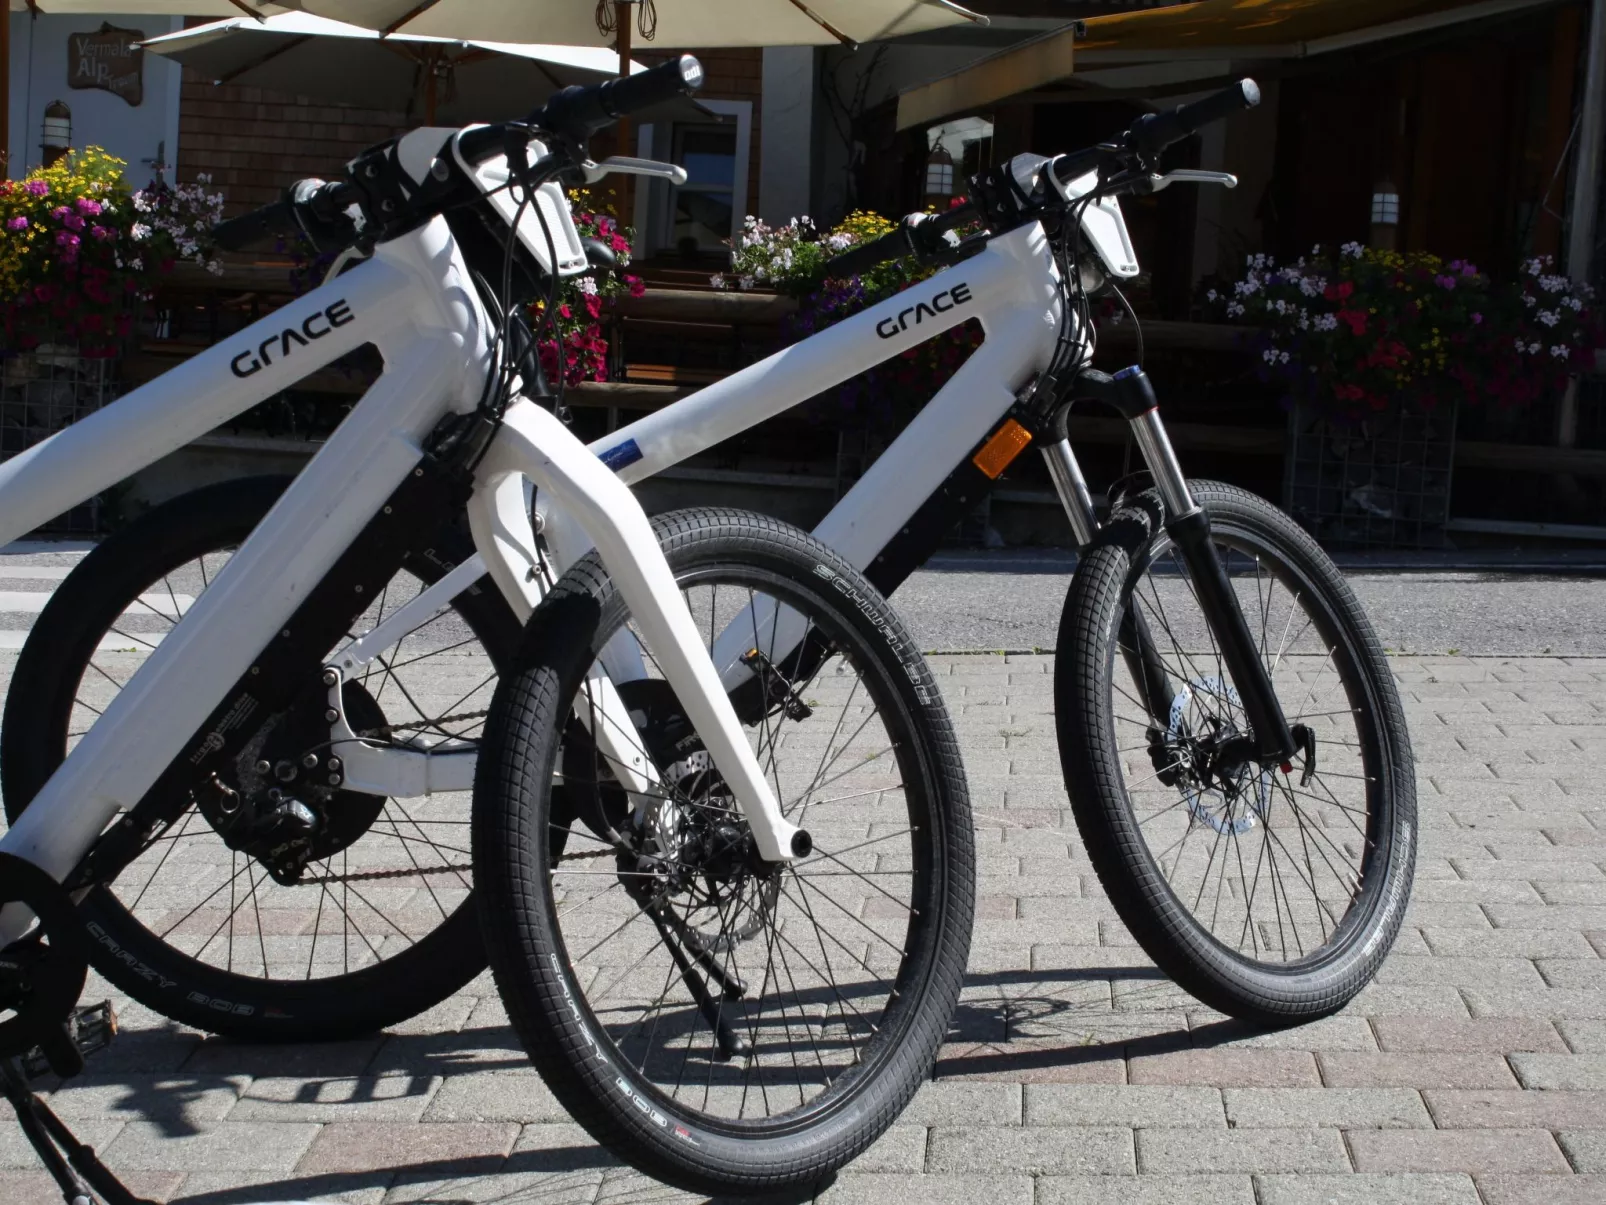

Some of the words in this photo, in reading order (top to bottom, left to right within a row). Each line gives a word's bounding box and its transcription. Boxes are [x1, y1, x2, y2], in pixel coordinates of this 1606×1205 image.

[76, 57, 110, 84] Alp
[812, 564, 931, 706] SCHWALBE
[85, 920, 178, 989] CRAZY
[185, 990, 255, 1016] BOB
[549, 952, 608, 1064] CRAZY
